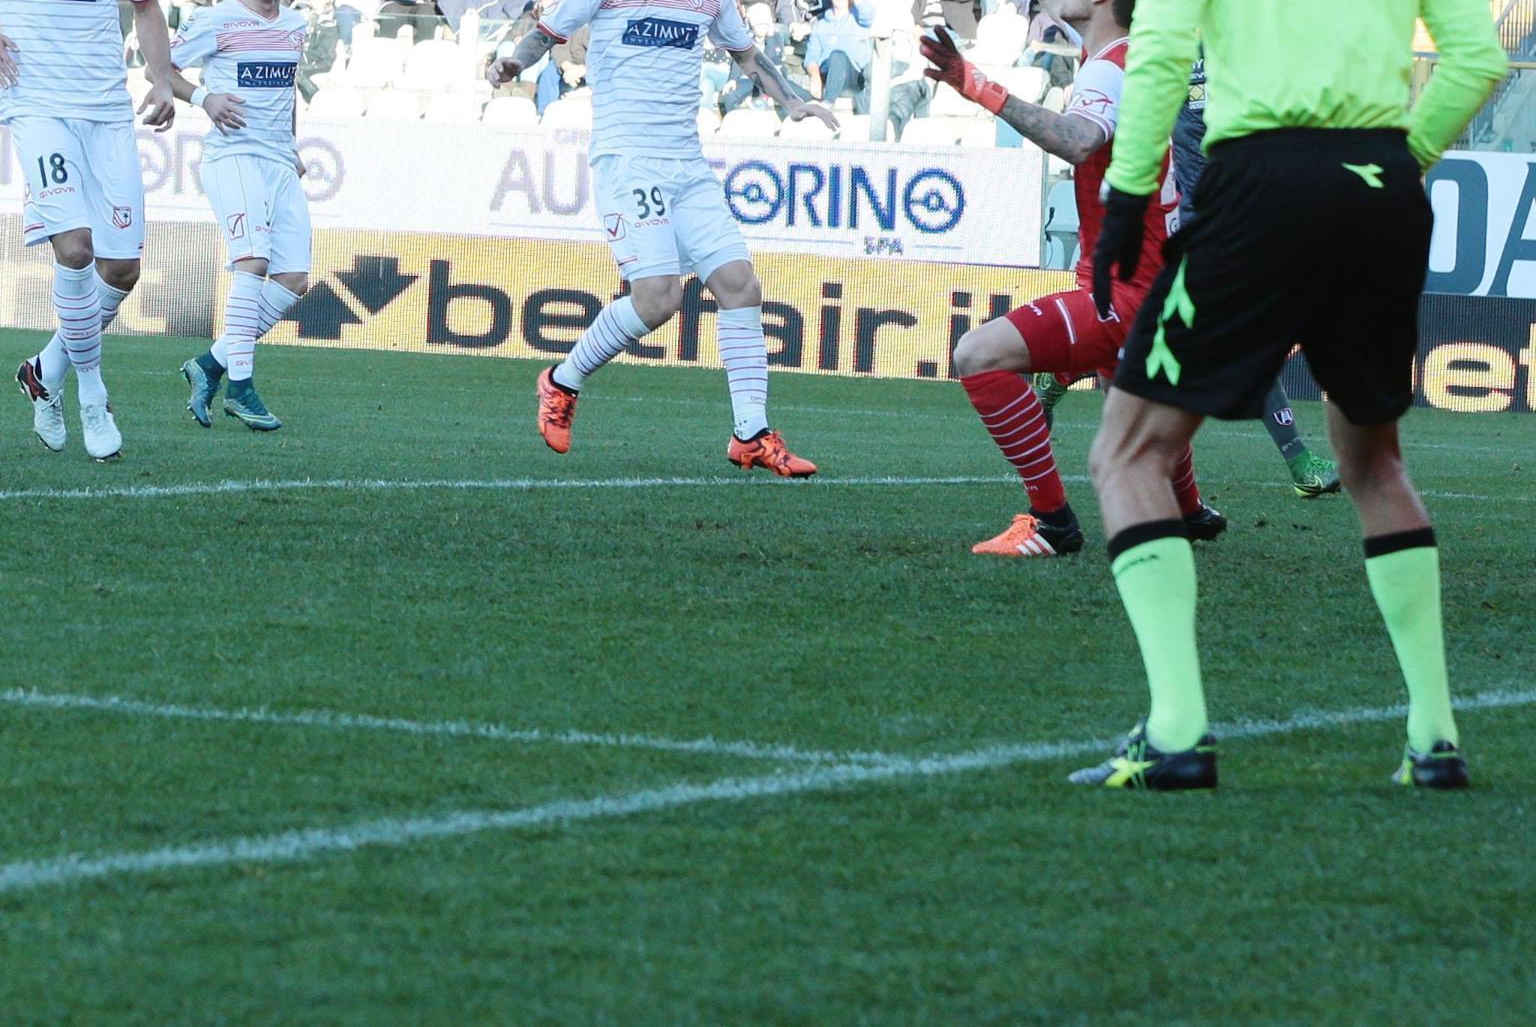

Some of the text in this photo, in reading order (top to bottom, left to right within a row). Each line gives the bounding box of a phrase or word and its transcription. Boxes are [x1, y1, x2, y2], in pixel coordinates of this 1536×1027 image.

[38, 153, 68, 188] 18
[40, 187, 75, 198] GIVOVA
[633, 186, 665, 219] 39
[864, 235, 904, 256] SPA
